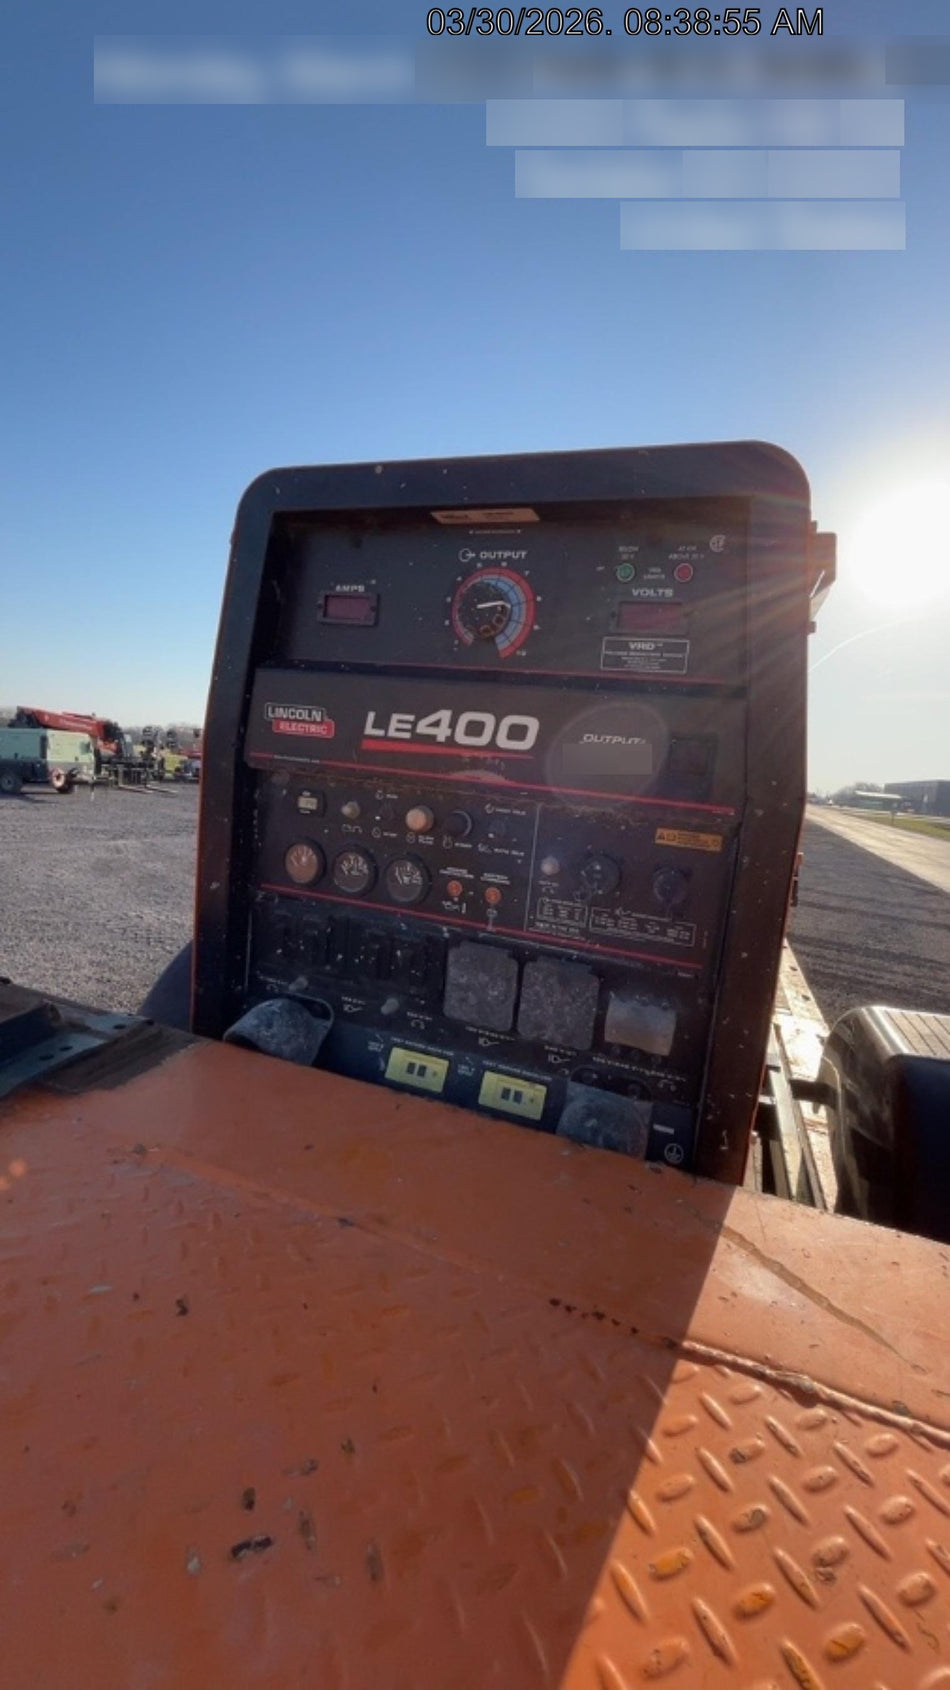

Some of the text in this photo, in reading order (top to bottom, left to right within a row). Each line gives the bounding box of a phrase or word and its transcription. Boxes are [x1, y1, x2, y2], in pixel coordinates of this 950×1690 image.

[480, 550, 528, 559] OUTPUT
[335, 584, 365, 592] AMPS
[631, 588, 674, 597] VOLTS
[267, 706, 323, 721] LINCOLN
[279, 722, 328, 735] ELECTRIC
[363, 709, 540, 751] LE400
